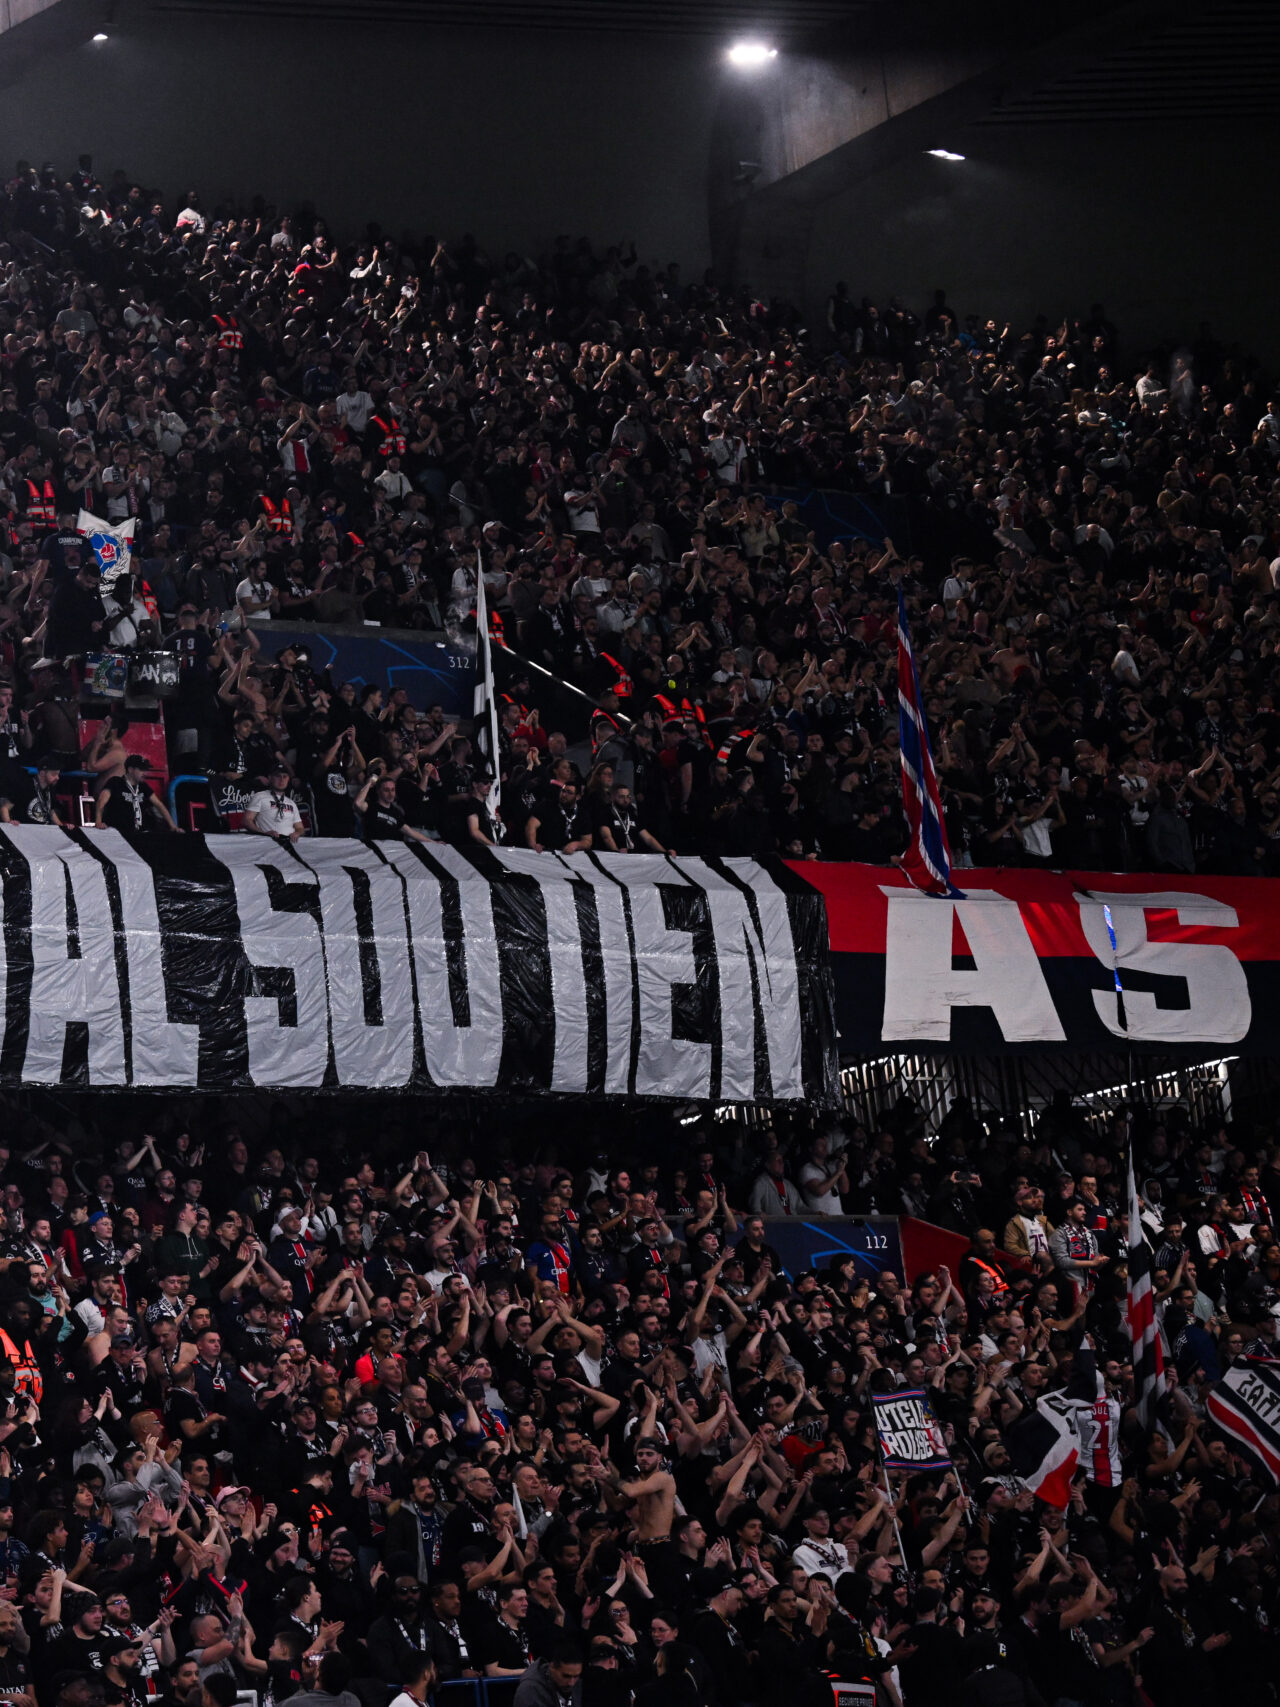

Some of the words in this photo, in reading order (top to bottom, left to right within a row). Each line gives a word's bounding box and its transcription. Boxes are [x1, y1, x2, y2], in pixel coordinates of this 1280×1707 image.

[447, 655, 471, 669] 312
[203, 833, 806, 1103] SOUTIEN
[865, 1235, 889, 1249] 112
[1087, 1419, 1112, 1449] 21
